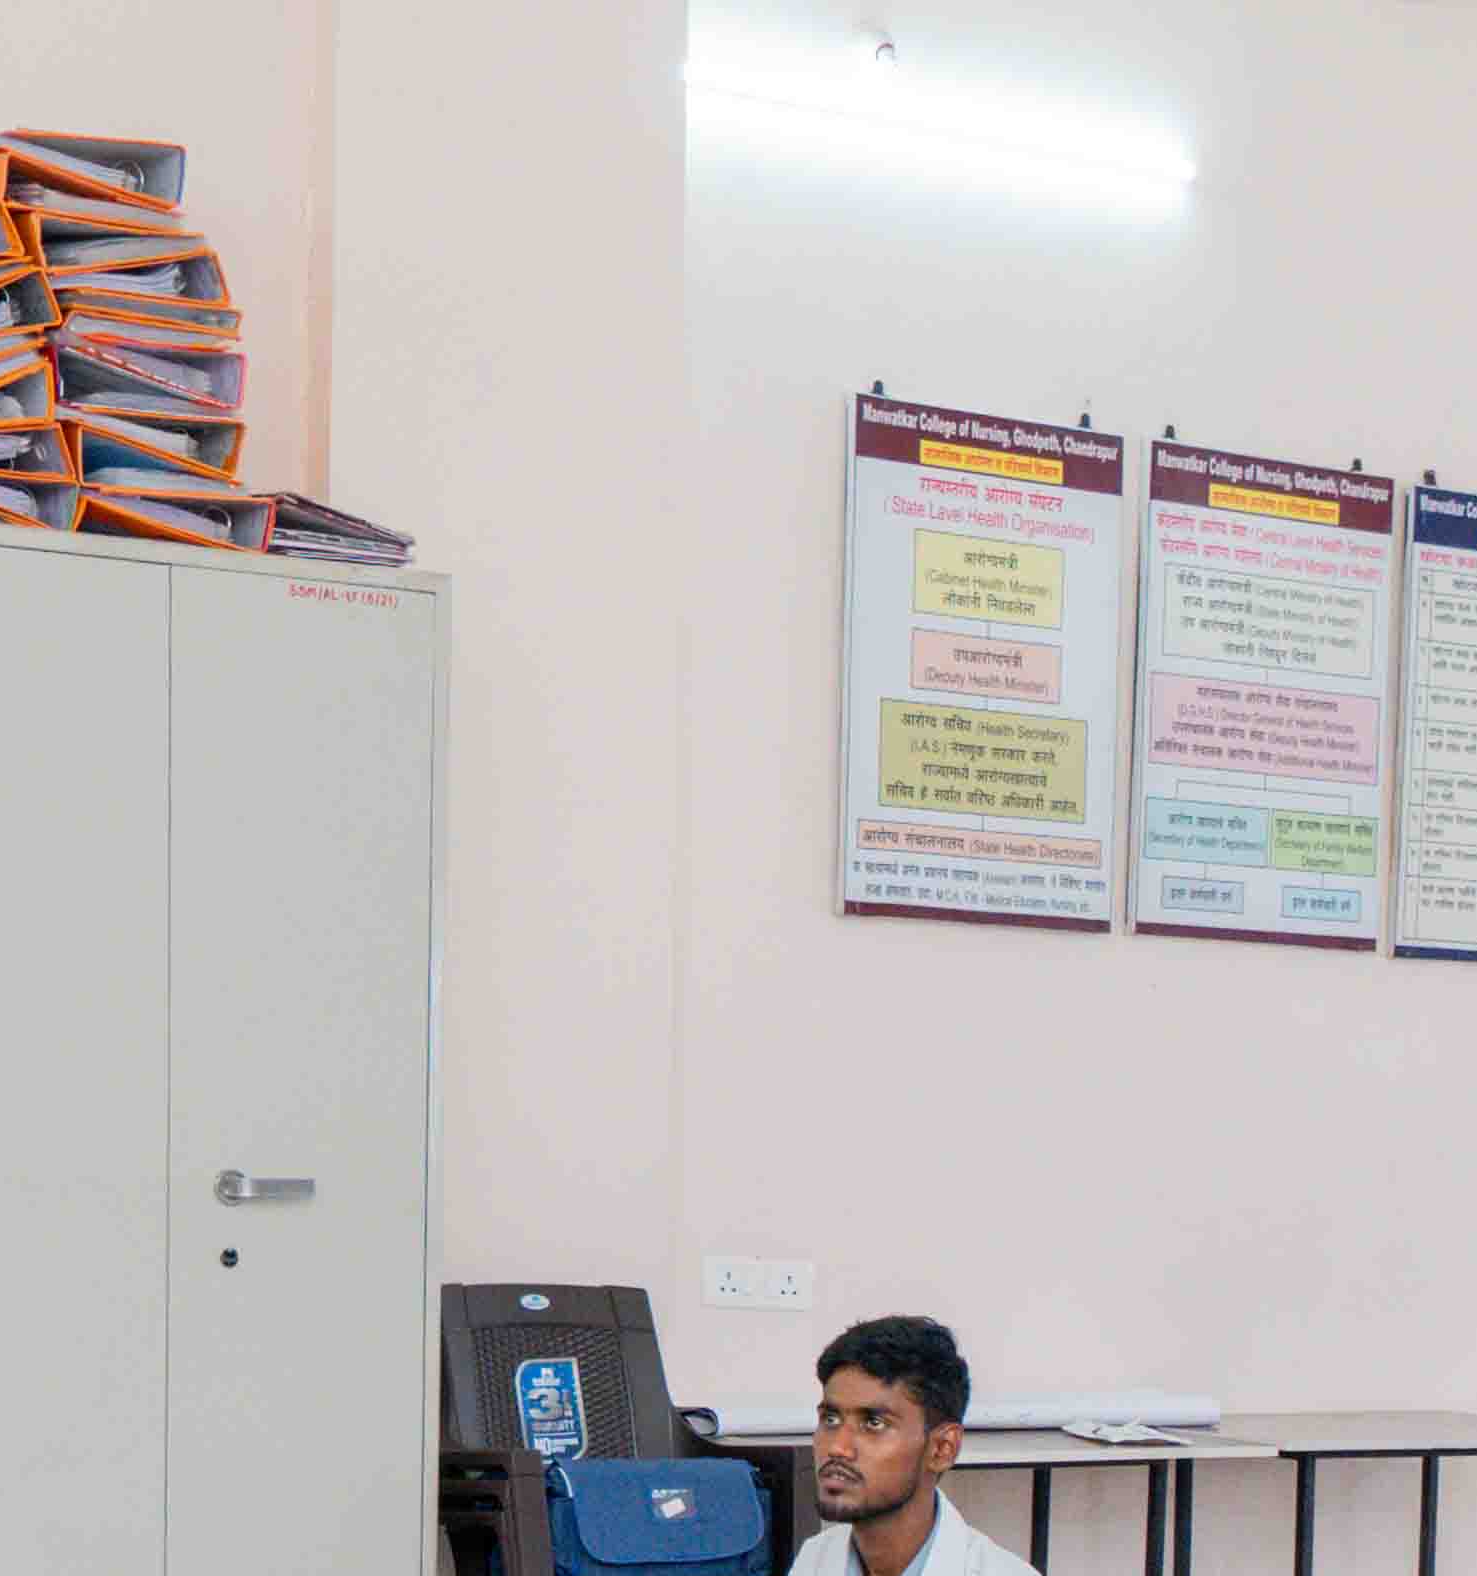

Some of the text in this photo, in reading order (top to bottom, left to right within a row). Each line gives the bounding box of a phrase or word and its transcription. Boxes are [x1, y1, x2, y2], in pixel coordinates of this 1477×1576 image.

[919, 412, 957, 439] College
[959, 418, 970, 434] of
[971, 421, 1011, 448] Nursing,
[1063, 437, 1117, 462] Chandrapur
[1245, 465, 1254, 480] of
